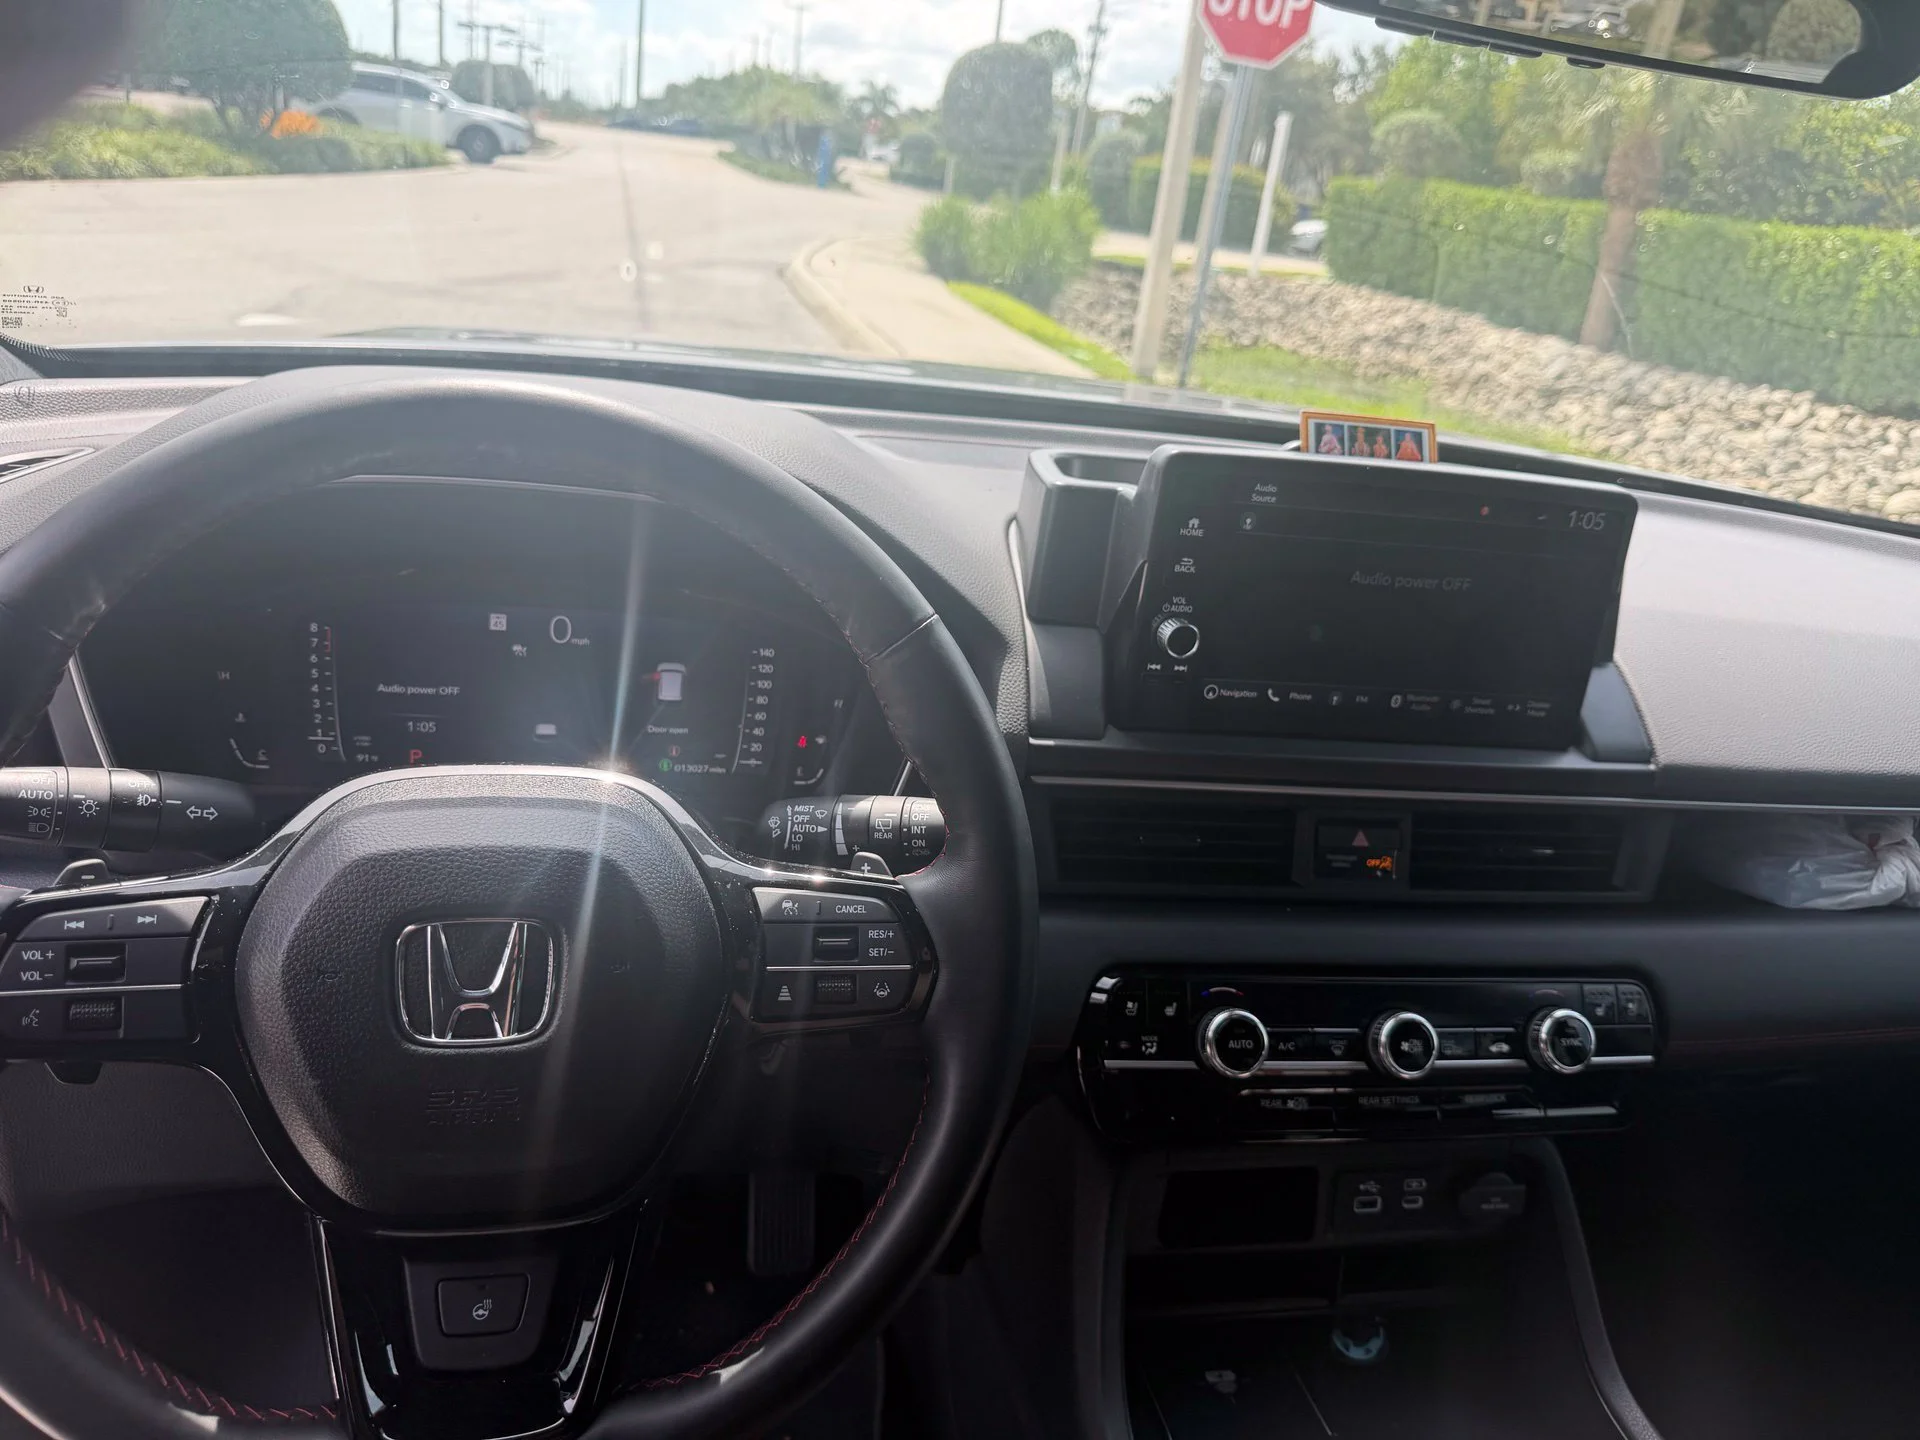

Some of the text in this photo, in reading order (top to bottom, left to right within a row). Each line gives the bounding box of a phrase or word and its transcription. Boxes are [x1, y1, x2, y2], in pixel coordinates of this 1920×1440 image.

[1255, 482, 1278, 493] Audio
[1251, 494, 1277, 504] Source
[1568, 510, 1606, 531] 1:05
[1180, 528, 1205, 537] HOME
[1174, 565, 1196, 574] BACK
[1350, 571, 1472, 592] Audio power OFF
[1173, 596, 1187, 604] VOL
[1171, 605, 1193, 613] AUDIO
[309, 622, 319, 632] 8
[550, 616, 590, 647] 0 mph
[310, 637, 319, 647] 7
[759, 648, 775, 657] 140
[310, 653, 318, 663] 6
[311, 668, 319, 678] 5
[758, 664, 774, 673] 120
[311, 684, 319, 692] 4
[756, 680, 773, 689] 100
[377, 683, 461, 696] Audio power OFF
[1219, 688, 1258, 699] Navigation
[756, 696, 769, 705] 80
[1289, 692, 1312, 701] Phone
[312, 699, 320, 708] 3
[313, 714, 322, 723] 2
[755, 712, 767, 720] 60
[407, 722, 437, 733] 1:05
[647, 725, 689, 735] Door open
[752, 727, 765, 736] 40
[750, 743, 762, 752] 20
[409, 749, 423, 763] P
[31, 776, 55, 785] OFF
[128, 779, 152, 788] OFF
[18, 789, 54, 800] AUTO
[911, 813, 930, 821] OFF
[792, 824, 817, 833] AUTO
[911, 826, 927, 834] INT
[791, 834, 804, 842] LO
[791, 843, 801, 851] HI
[911, 839, 926, 847] ON
[835, 904, 867, 914] CANCEL
[868, 929, 895, 939] RES/+
[1228, 1040, 1254, 1049] AUTO
[1278, 1042, 1296, 1051] A/C
[1358, 1095, 1420, 1105] REAR SETTINGS
